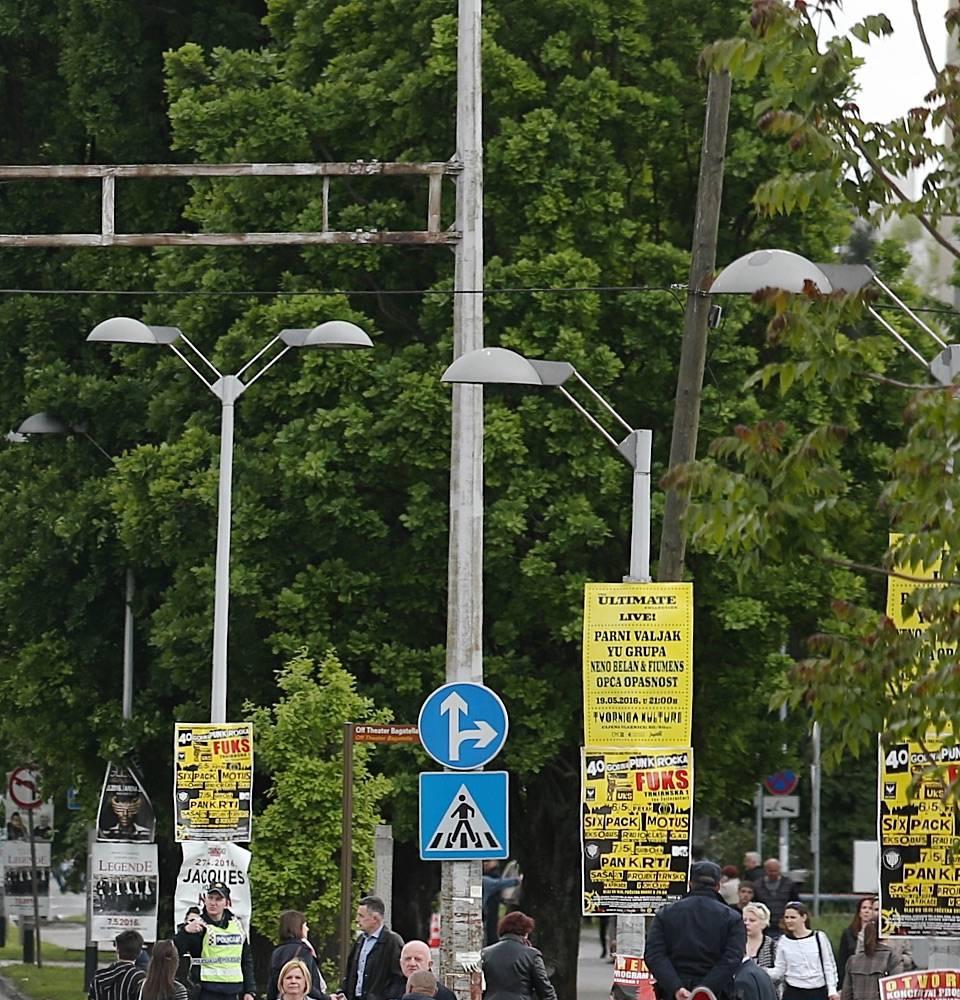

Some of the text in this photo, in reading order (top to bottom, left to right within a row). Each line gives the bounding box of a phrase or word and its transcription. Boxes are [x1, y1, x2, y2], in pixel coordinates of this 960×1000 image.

[598, 595, 677, 605] ULTIMATE
[619, 613, 656, 621] LIVE!
[594, 630, 681, 641] PARNI VALJAK
[607, 646, 666, 657] YU GRUPA
[590, 661, 685, 673] NENO BELAN & FIUMENS
[624, 676, 679, 687] OPASNOST
[367, 726, 389, 734] Theater
[179, 733, 192, 744] 40
[213, 739, 251, 755] FUKS
[886, 749, 908, 768] 40
[587, 760, 605, 776] 40
[629, 757, 655, 769] PUNK
[657, 754, 688, 767] ROCKA
[178, 772, 251, 780] SIX PACK MOTUS
[635, 769, 690, 792] FUKS
[190, 800, 238, 809] PANKRTI
[585, 815, 689, 828] SIX PACK MOTUS
[883, 818, 950, 832] SIX PACK
[99, 861, 152, 873] LEGENDE
[601, 857, 670, 868] PANKRTI
[183, 868, 245, 885] JACQUES
[886, 972, 957, 992] OTVOR
